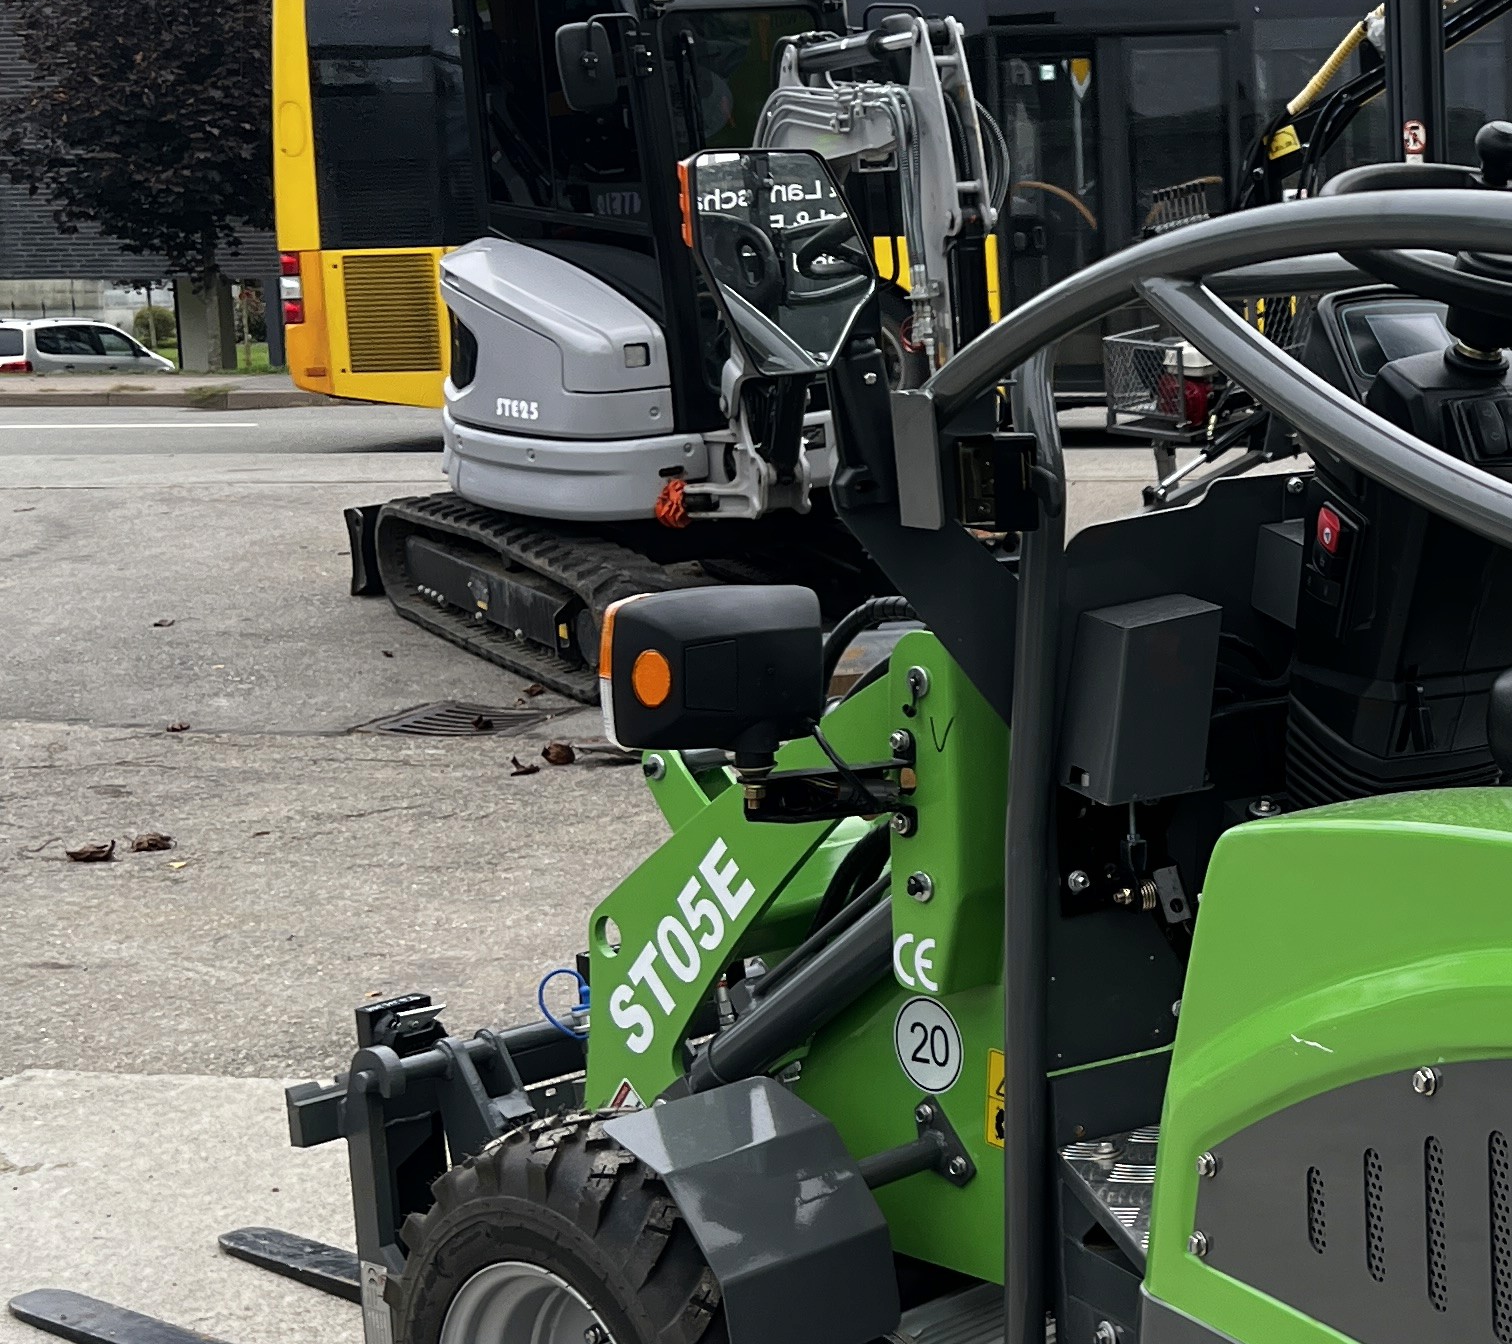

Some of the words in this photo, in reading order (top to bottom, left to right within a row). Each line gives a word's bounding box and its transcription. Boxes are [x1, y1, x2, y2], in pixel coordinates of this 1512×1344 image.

[496, 397, 539, 420] STE25
[610, 836, 755, 1054] ST05E
[893, 933, 938, 992] CE
[909, 1021, 949, 1068] 20
